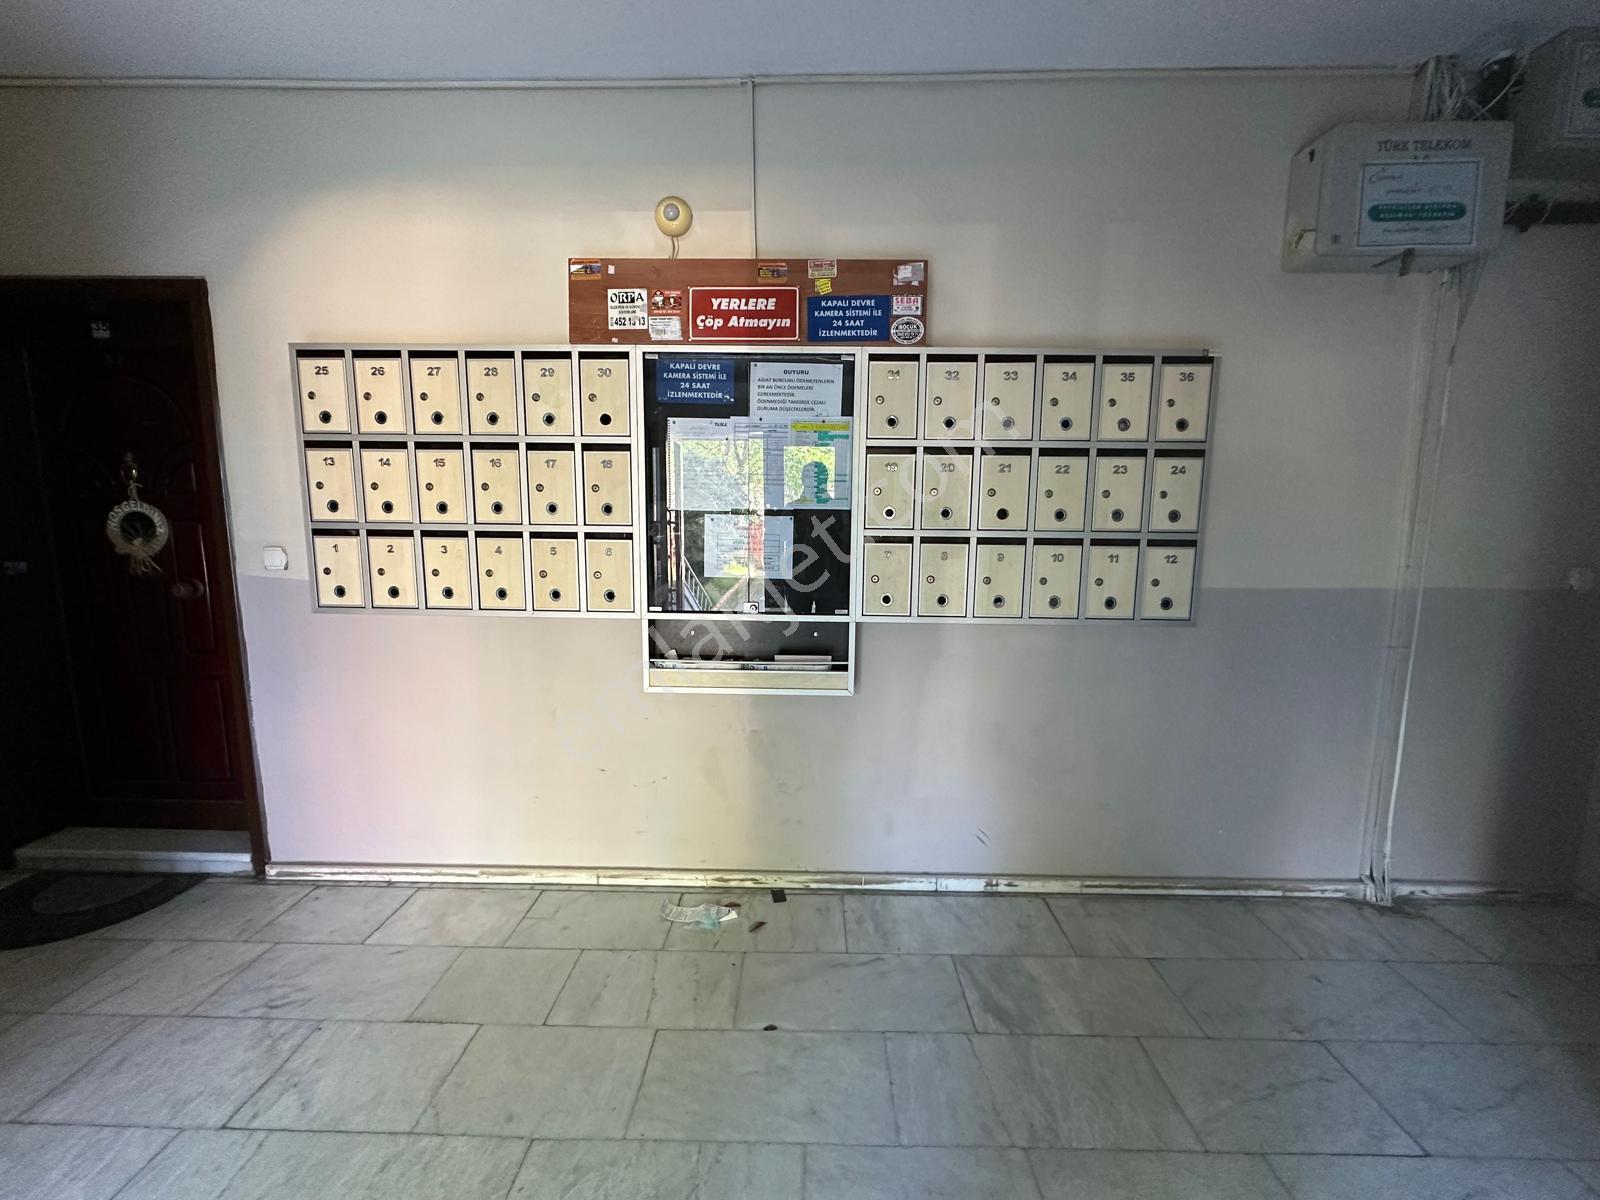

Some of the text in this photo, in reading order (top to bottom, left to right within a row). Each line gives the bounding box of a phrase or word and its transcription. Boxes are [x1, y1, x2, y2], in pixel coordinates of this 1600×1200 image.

[1413, 139, 1472, 152] TELEKOM
[611, 292, 644, 304] ORPA
[851, 299, 875, 307] DEVRE
[711, 298, 776, 310] YERLERE
[845, 308, 871, 317] SİSTEMİ
[872, 308, 882, 317] İLE
[614, 317, 627, 326] 452
[696, 315, 724, 330] Çöp
[728, 315, 791, 330] Atmayın
[818, 328, 878, 337] İZLENMEKTEDİR
[315, 366, 329, 376] 25
[371, 367, 385, 376] 26
[427, 367, 441, 376] 27
[540, 368, 555, 378] 29
[597, 368, 612, 378] 30
[663, 371, 727, 380] KAMERA SİSTEMİ İLE
[945, 370, 960, 381] 32
[1003, 371, 1019, 381] 33
[1062, 371, 1077, 381] 34
[1120, 372, 1135, 382] 35
[1179, 372, 1195, 382] 36
[667, 389, 723, 399] İZLENMEKTEDİR
[323, 457, 336, 466] 13
[378, 458, 391, 467] 14
[434, 458, 446, 467] 15
[490, 458, 502, 468] 16
[545, 459, 557, 468] 17
[939, 463, 955, 473] 20
[998, 463, 1012, 473] 21
[1055, 465, 1070, 475] 22
[1112, 465, 1128, 475] 23
[1170, 465, 1186, 475] 24
[333, 544, 339, 553] 1
[387, 545, 395, 554] 2
[441, 545, 448, 554] 3
[495, 546, 503, 555] 4
[1050, 553, 1065, 563] 10
[1107, 554, 1120, 563] 11
[1164, 554, 1178, 564] 12
